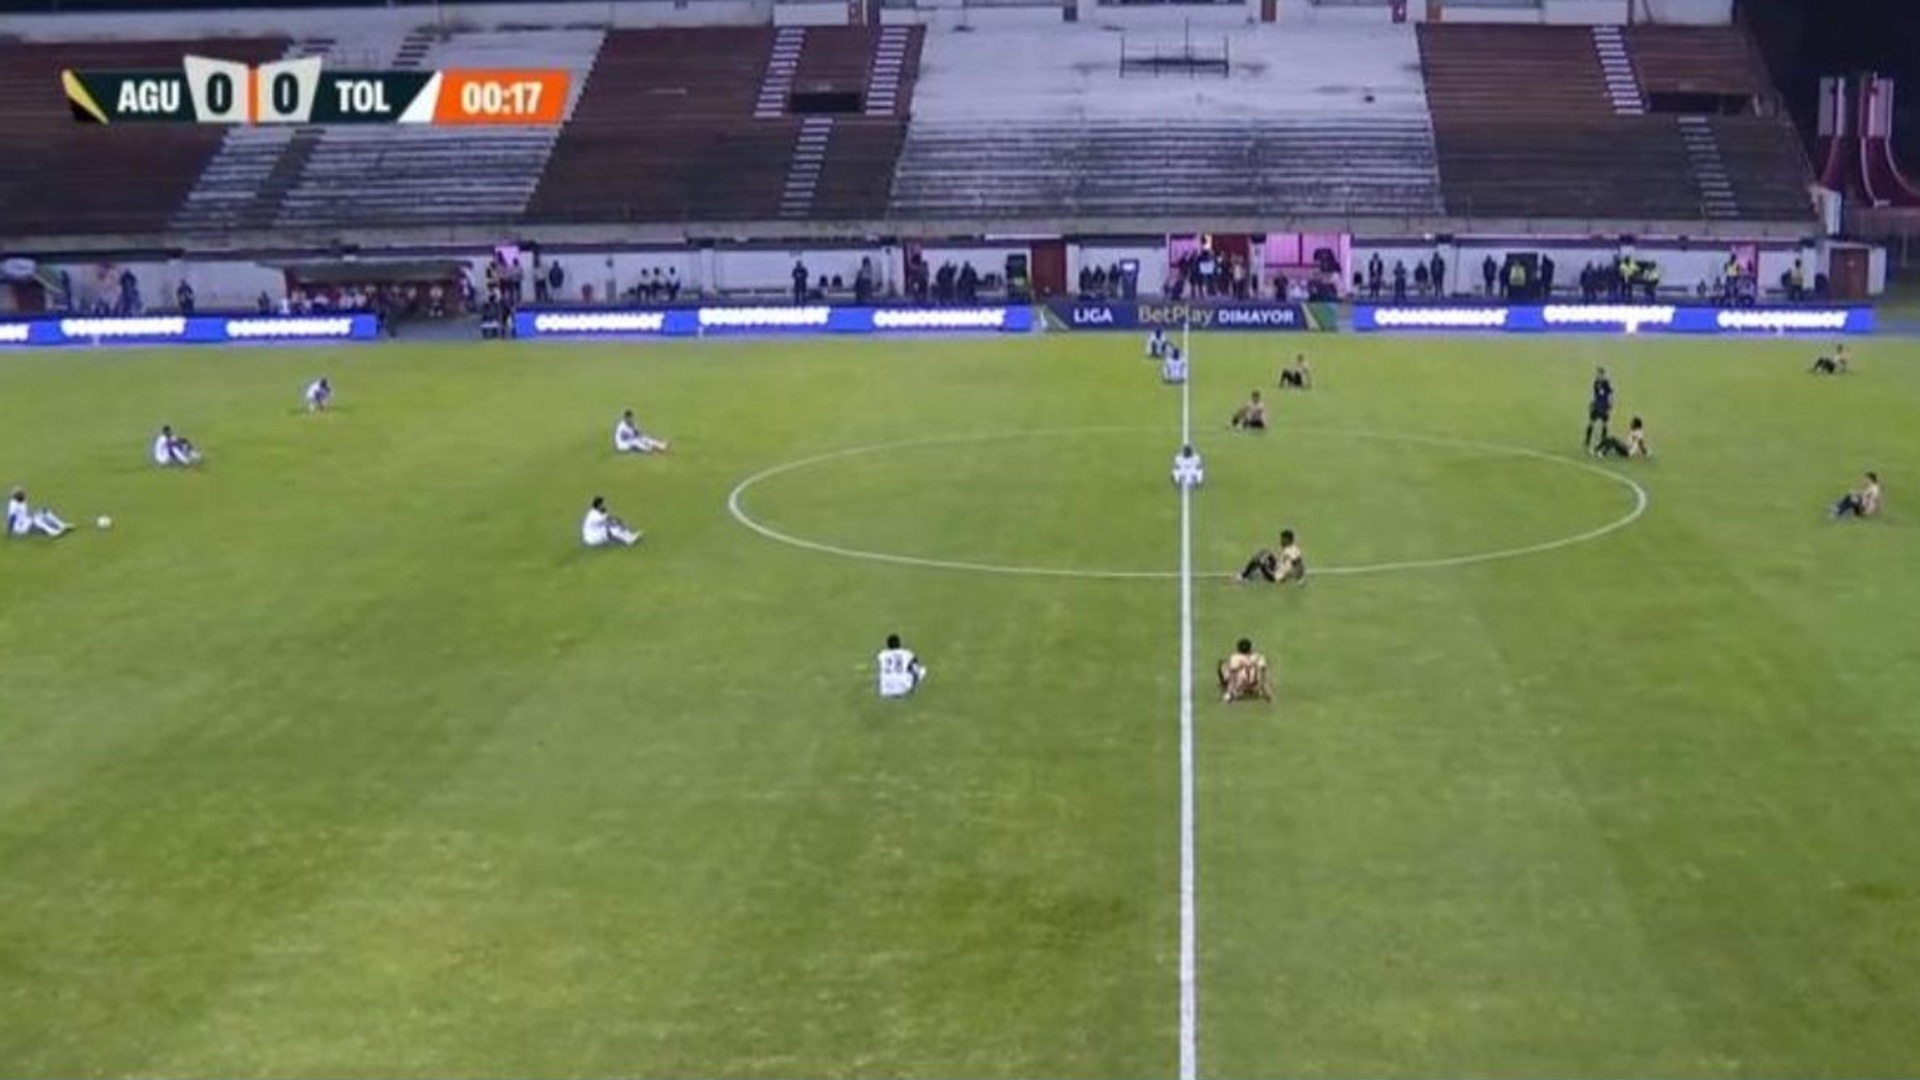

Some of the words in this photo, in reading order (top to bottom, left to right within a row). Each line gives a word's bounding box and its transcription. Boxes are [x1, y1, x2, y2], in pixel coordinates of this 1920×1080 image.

[1074, 308, 1113, 323] LIGA
[1138, 305, 1213, 327] BetPlay
[1218, 309, 1295, 324] DIMAYOR
